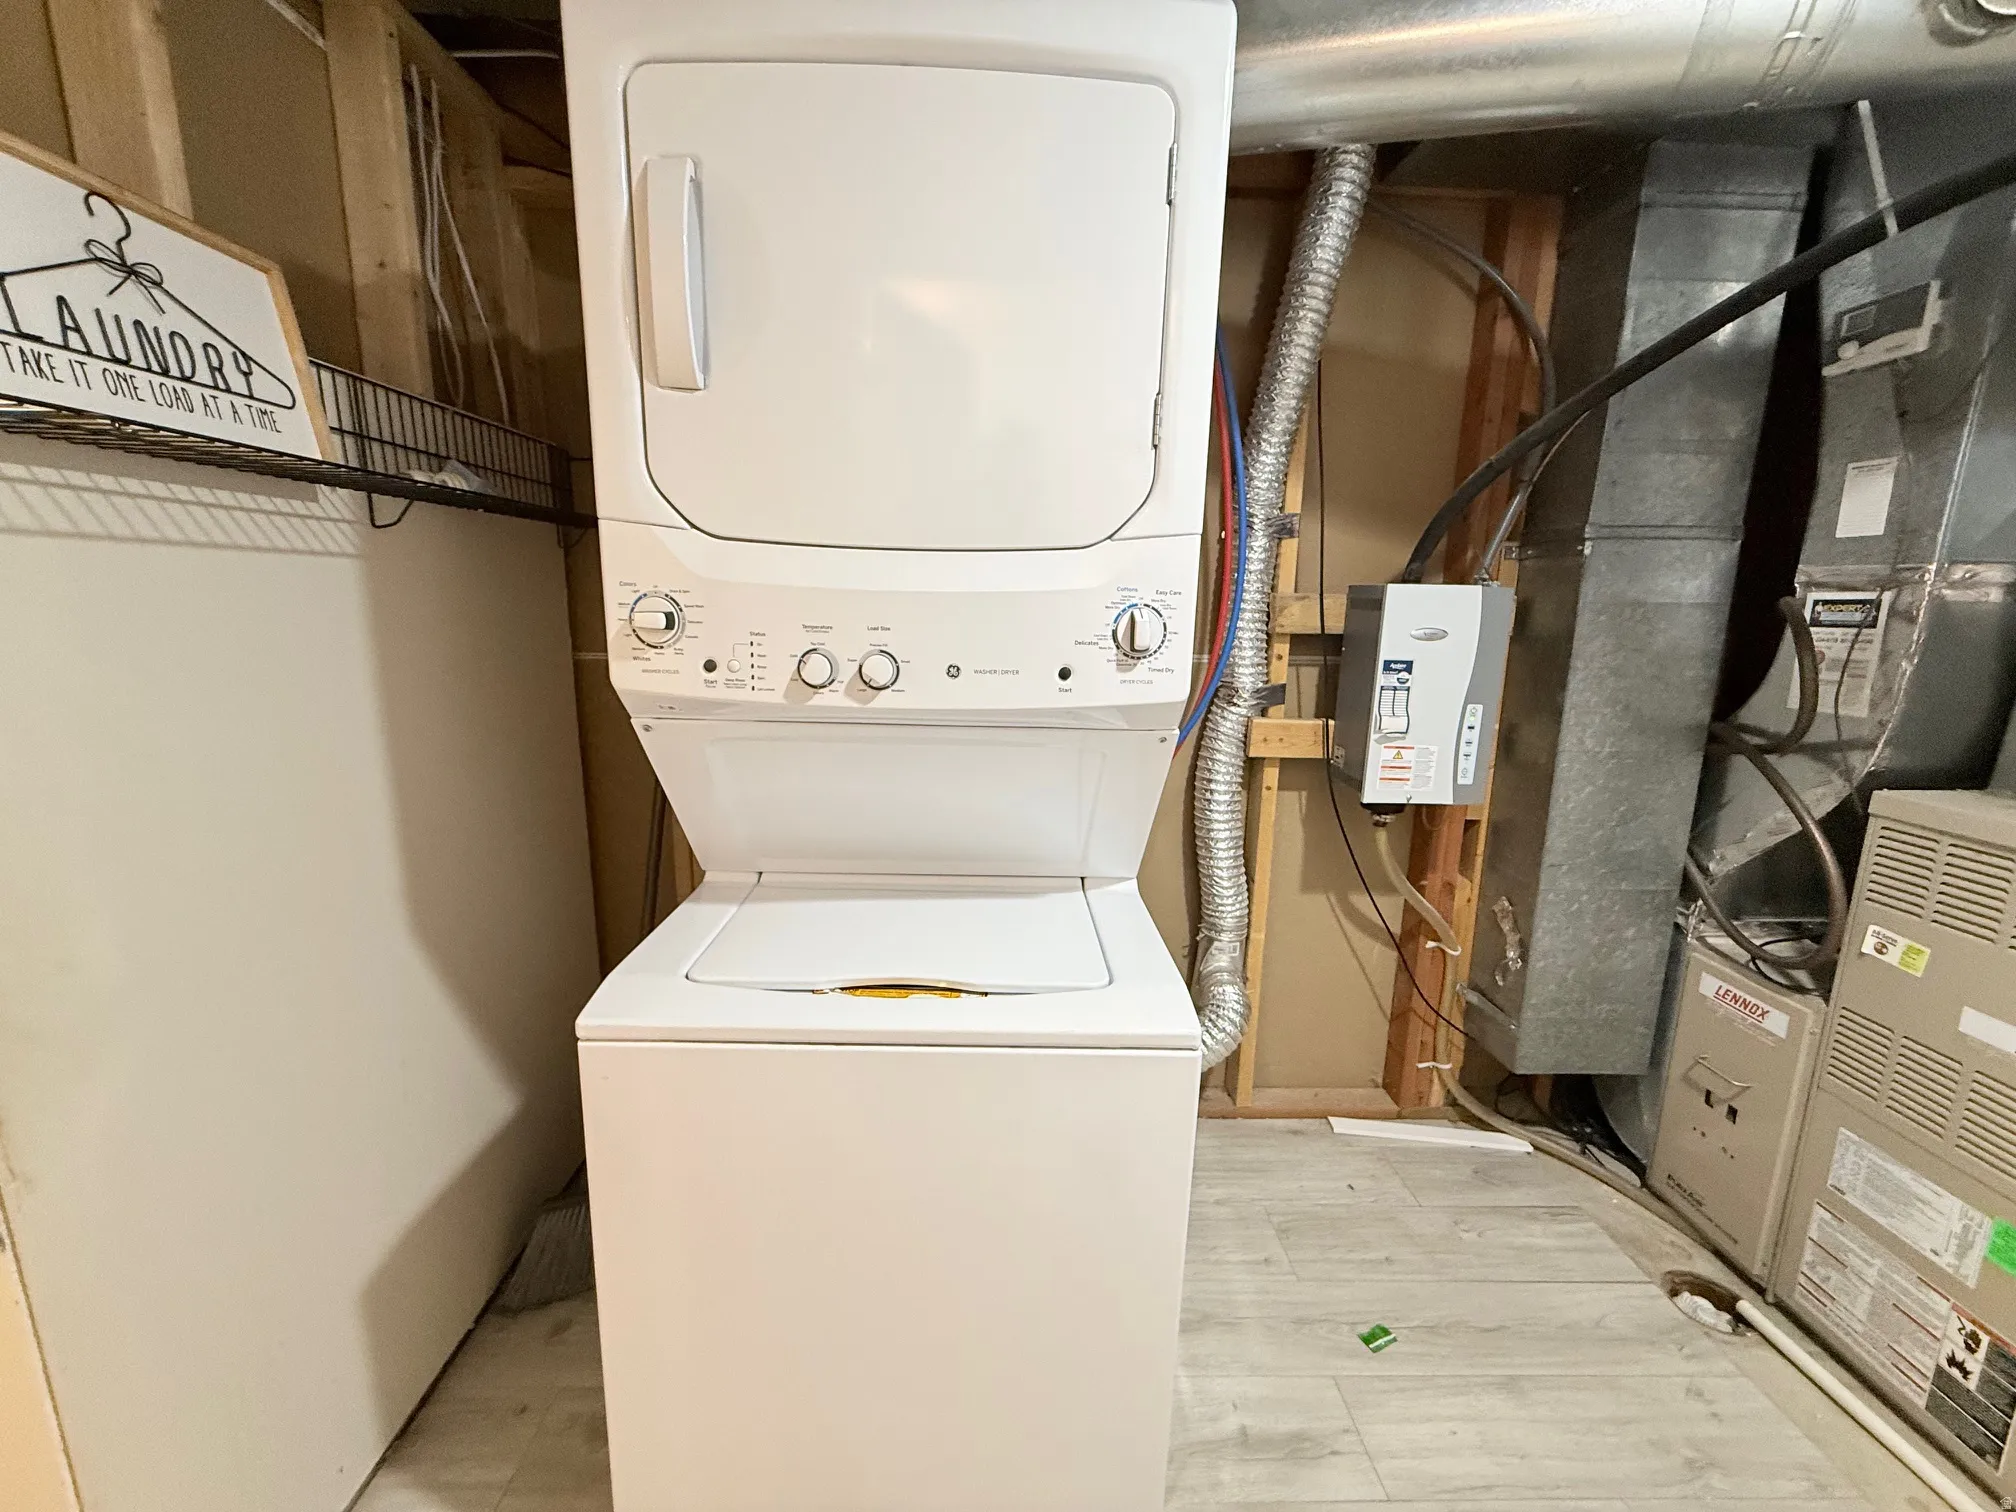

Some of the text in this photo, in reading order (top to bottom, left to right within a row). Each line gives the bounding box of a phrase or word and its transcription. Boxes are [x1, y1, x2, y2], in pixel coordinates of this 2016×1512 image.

[0, 274, 255, 400] LAUNDRY
[0, 341, 282, 433] TAKE IT ONE LOAD AT A TIME
[1156, 589, 1168, 597] Easy
[1715, 984, 1770, 1020] LENNOX
